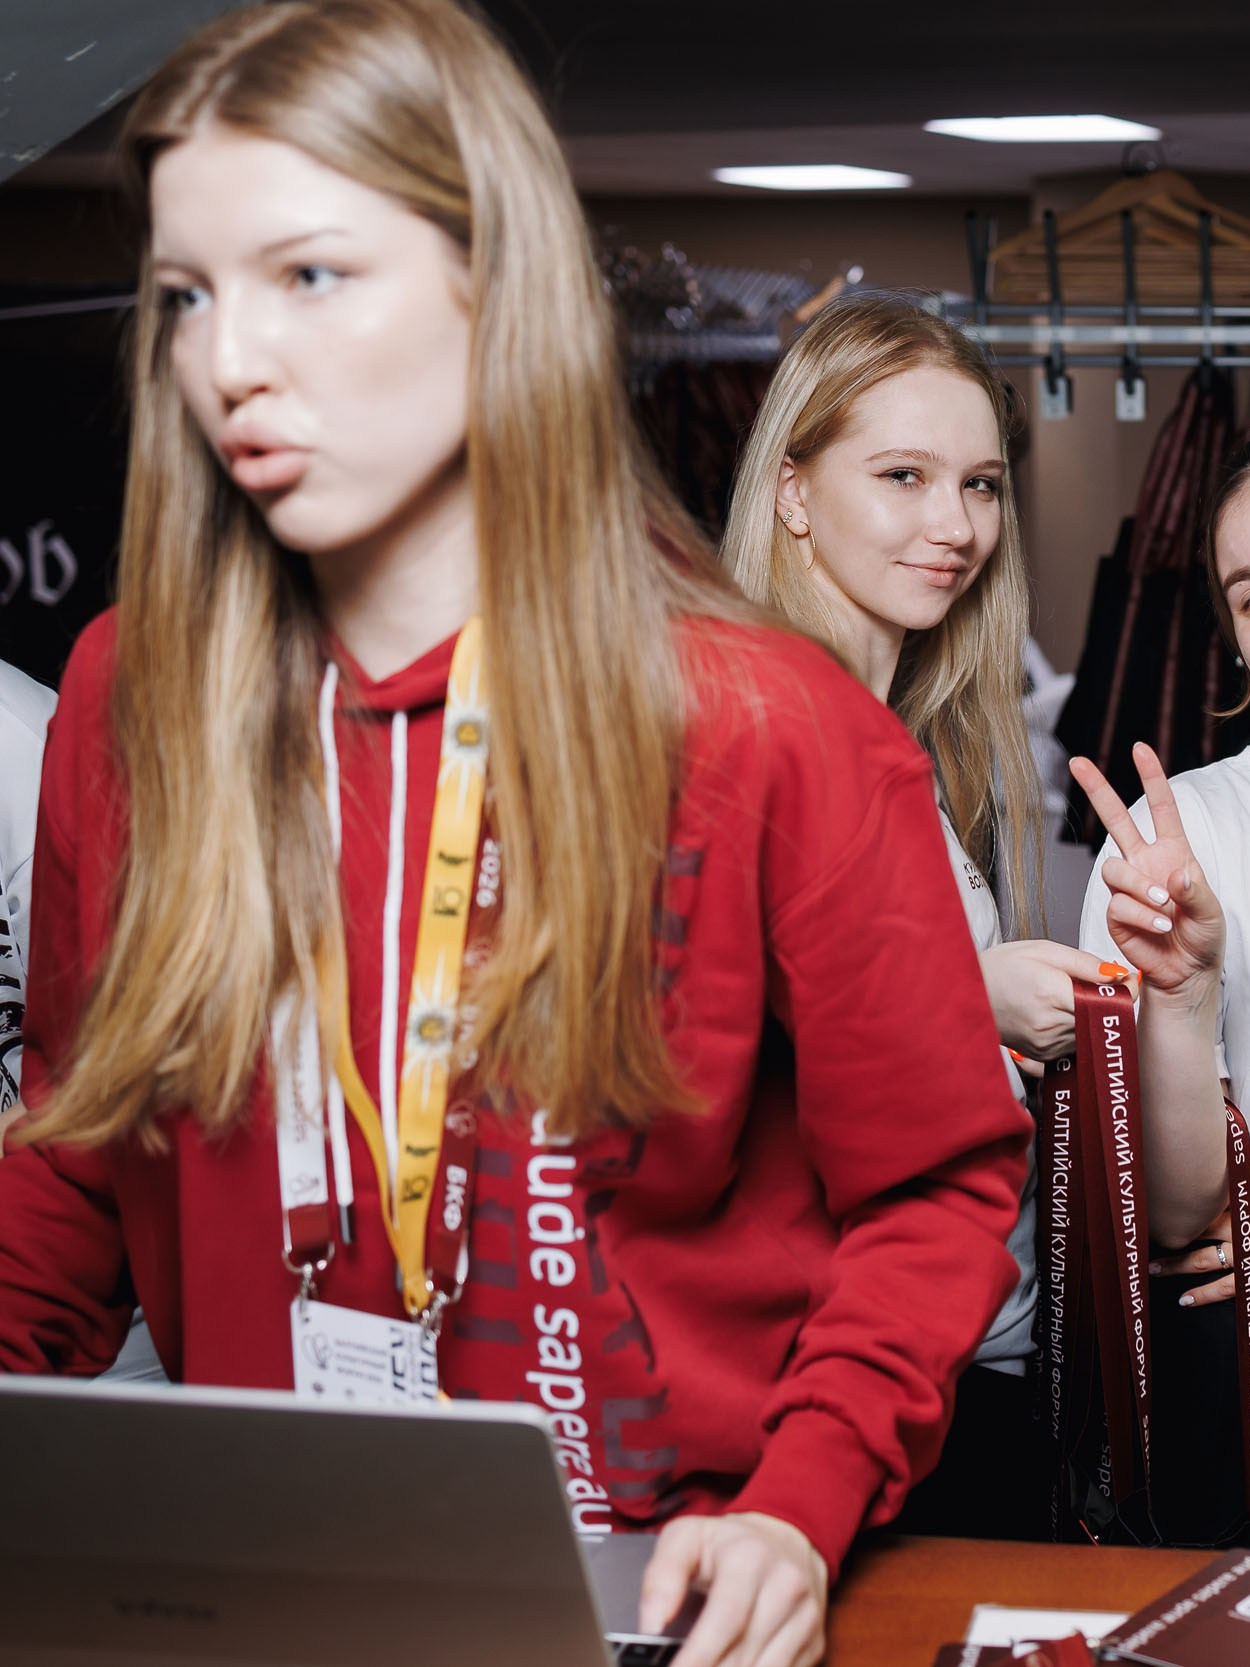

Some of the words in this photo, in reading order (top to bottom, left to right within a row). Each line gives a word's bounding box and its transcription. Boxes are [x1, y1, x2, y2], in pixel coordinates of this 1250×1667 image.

[1050, 1089, 1072, 1228] БАЛТИЙСКИЙ
[1103, 1015, 1134, 1166] БАЛТИЙСКИЙ
[1119, 1171, 1145, 1314] КУЛЬТУРНЫЙ
[1134, 1319, 1148, 1399] ФОРУМ
[1050, 1233, 1066, 1364] КУЛЬТУРНЫЙ
[1051, 1367, 1062, 1440] ФОРУМ
